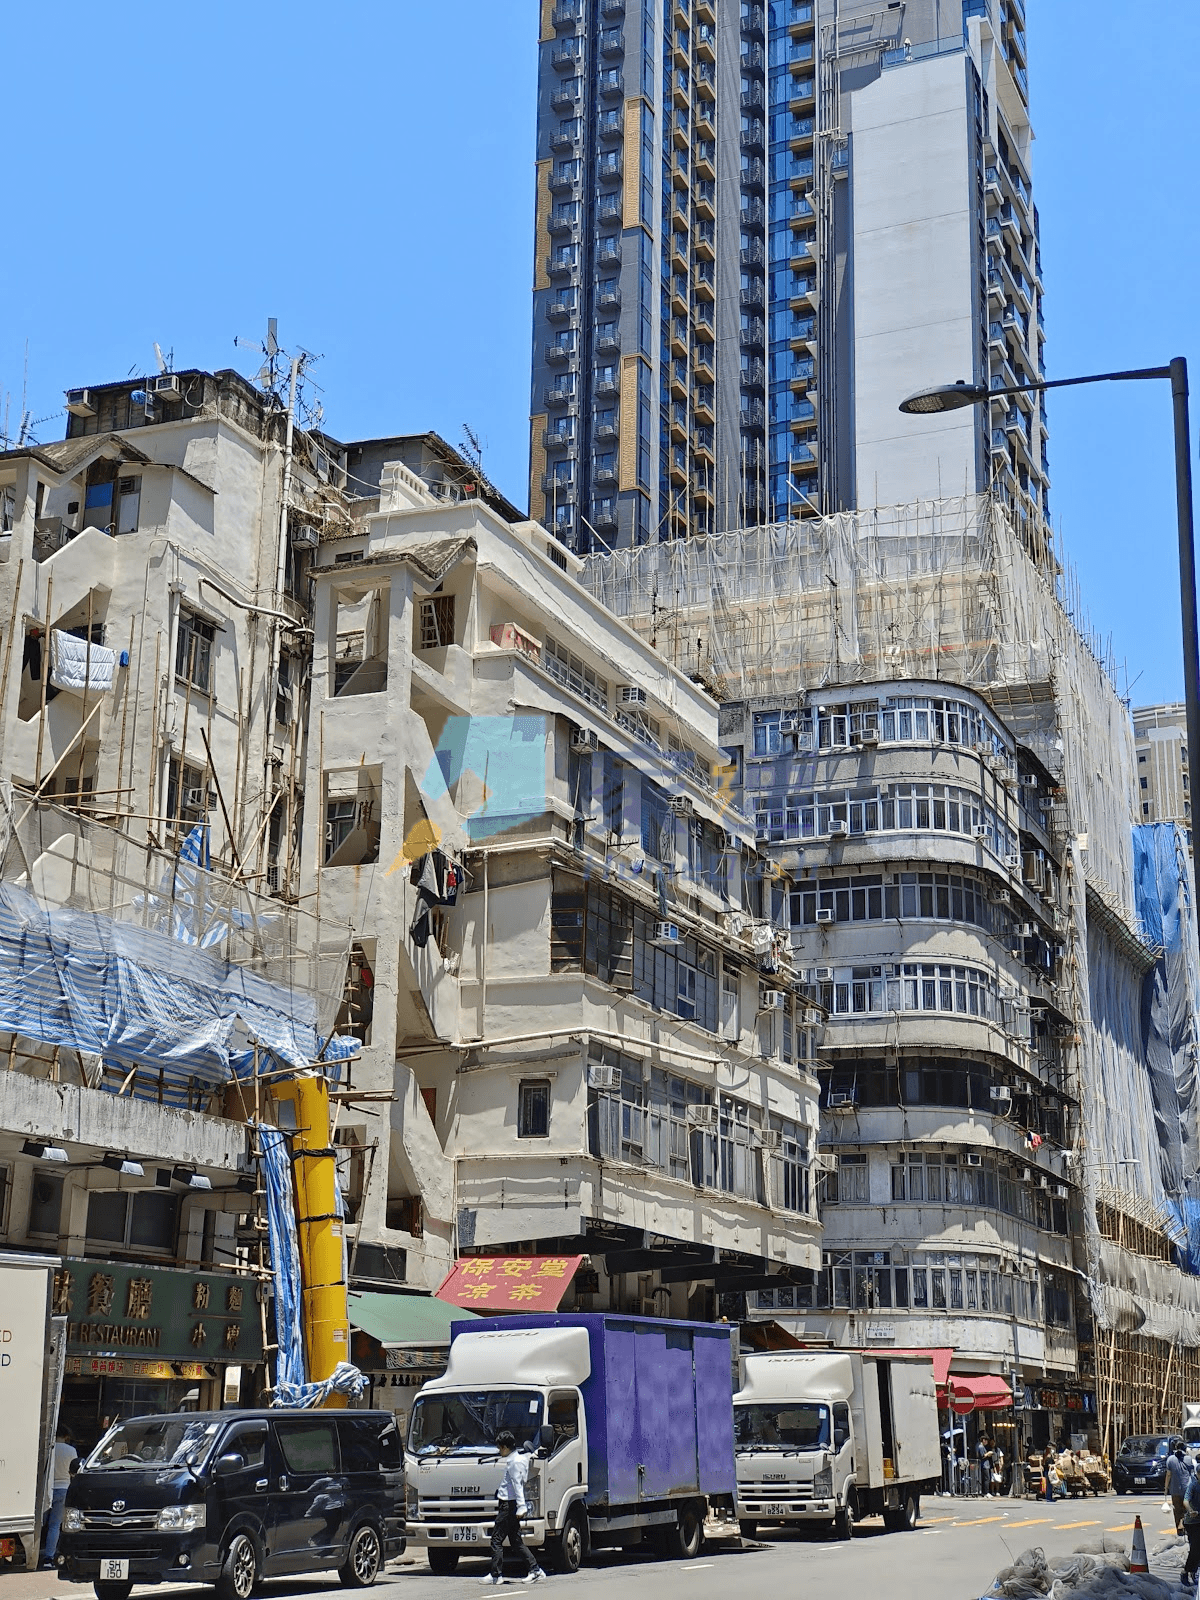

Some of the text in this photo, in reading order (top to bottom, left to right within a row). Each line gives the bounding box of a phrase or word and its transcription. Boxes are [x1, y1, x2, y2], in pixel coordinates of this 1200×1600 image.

[461, 1258, 568, 1277] 保安堂
[80, 1323, 162, 1348] RESTAURANT
[451, 1486, 481, 1494] ISUZU
[109, 1560, 121, 1570] SH
[106, 1569, 122, 1578] 150
